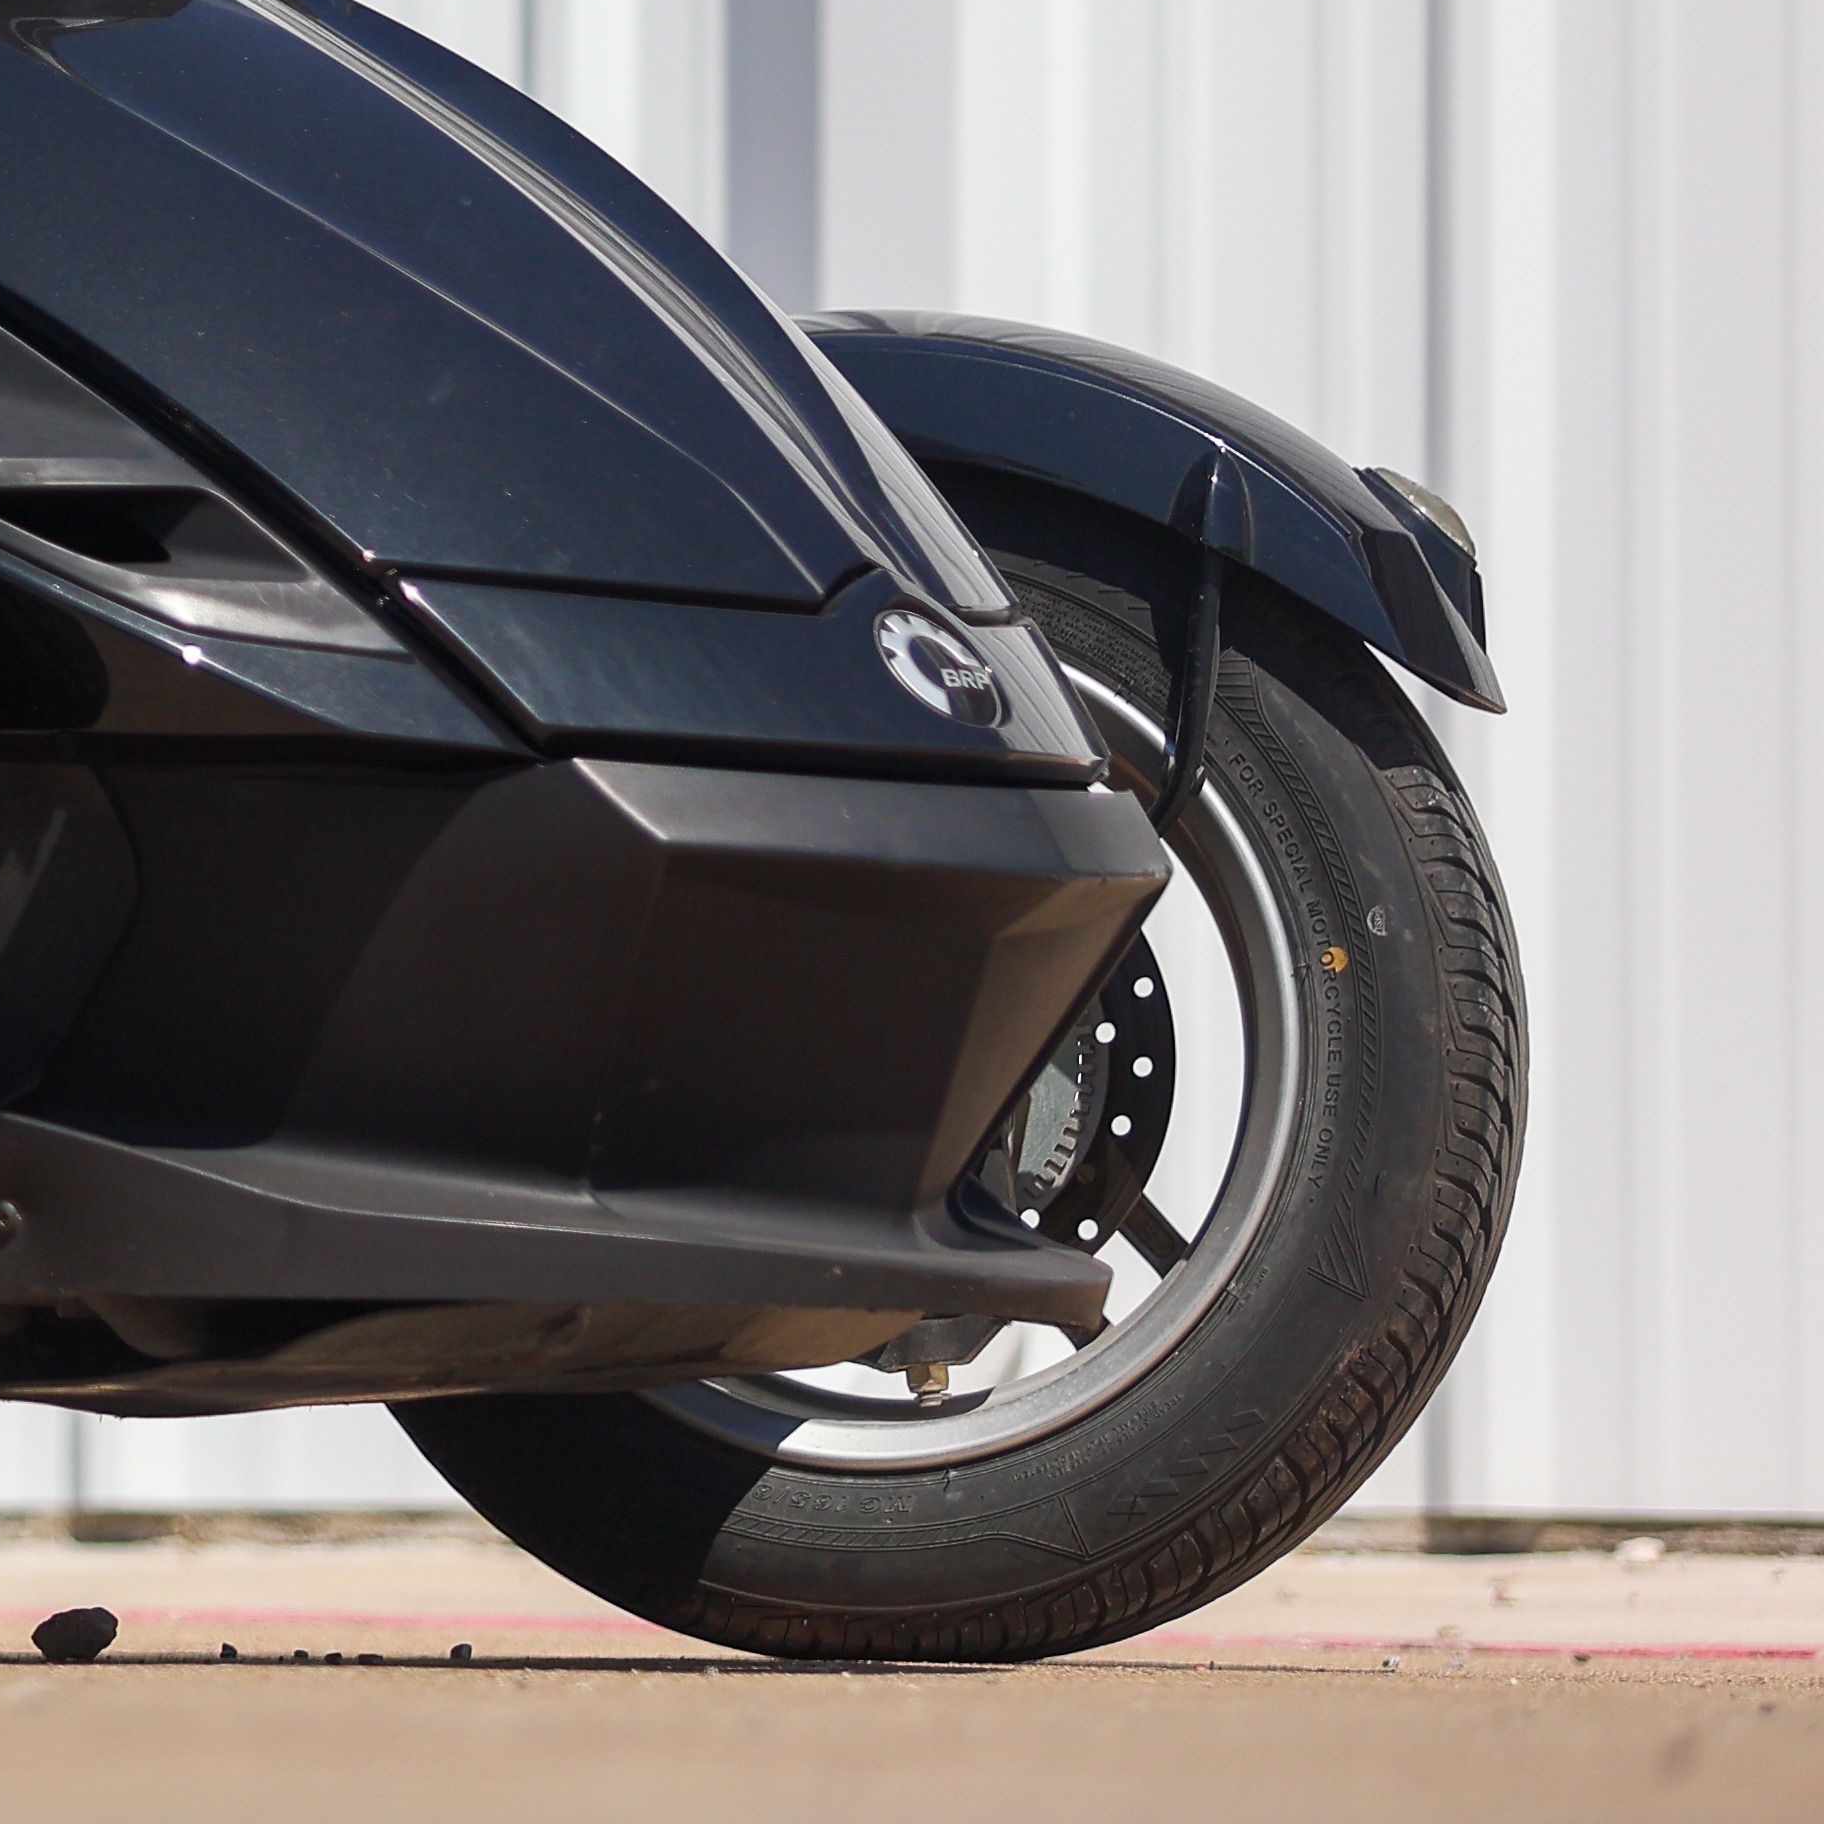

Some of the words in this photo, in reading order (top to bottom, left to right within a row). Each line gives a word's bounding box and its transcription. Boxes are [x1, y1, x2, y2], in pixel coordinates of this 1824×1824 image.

[940, 667, 992, 691] BRP
[1228, 751, 1266, 798] FOR
[1262, 800, 1314, 893] SPECIAL
[1306, 898, 1343, 1062] MOTORCYCLE
[1322, 1073, 1342, 1117] USE
[1307, 1127, 1334, 1189] ONLY
[752, 1484, 848, 1513] 165/6
